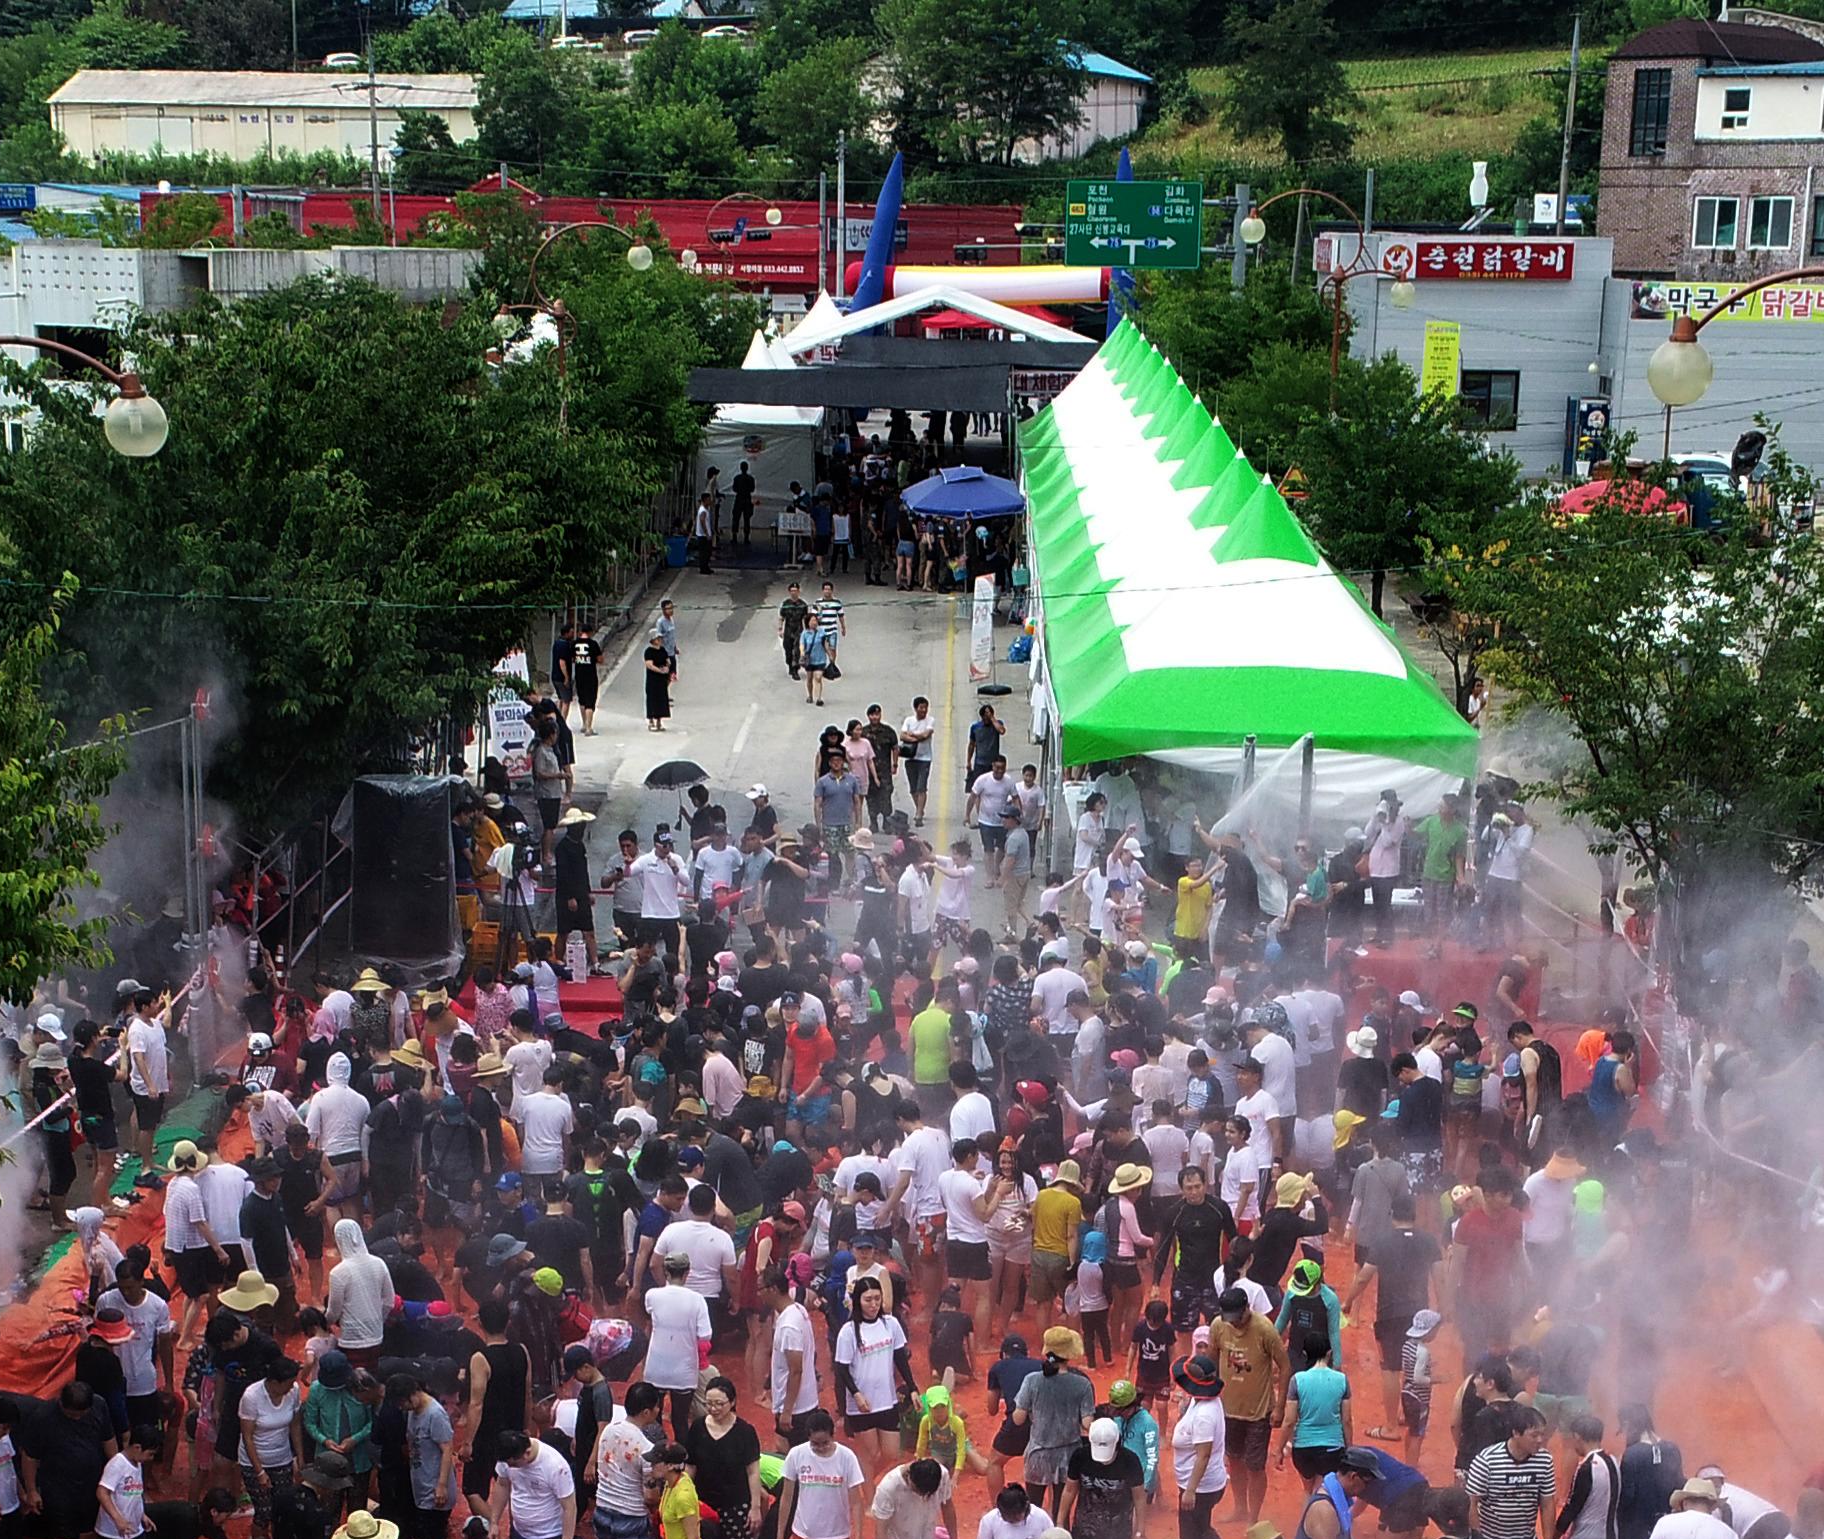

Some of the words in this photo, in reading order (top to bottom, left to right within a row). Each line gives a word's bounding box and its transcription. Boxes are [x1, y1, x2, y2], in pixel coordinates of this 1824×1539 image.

[1087, 184, 1108, 196] 포천
[1087, 203, 1108, 216] 철원
[1163, 205, 1195, 217] 다목리
[1069, 223, 1093, 235] 27사단
[494, 708, 526, 722] 탈의실
[1507, 1474, 1531, 1484] SPORT
